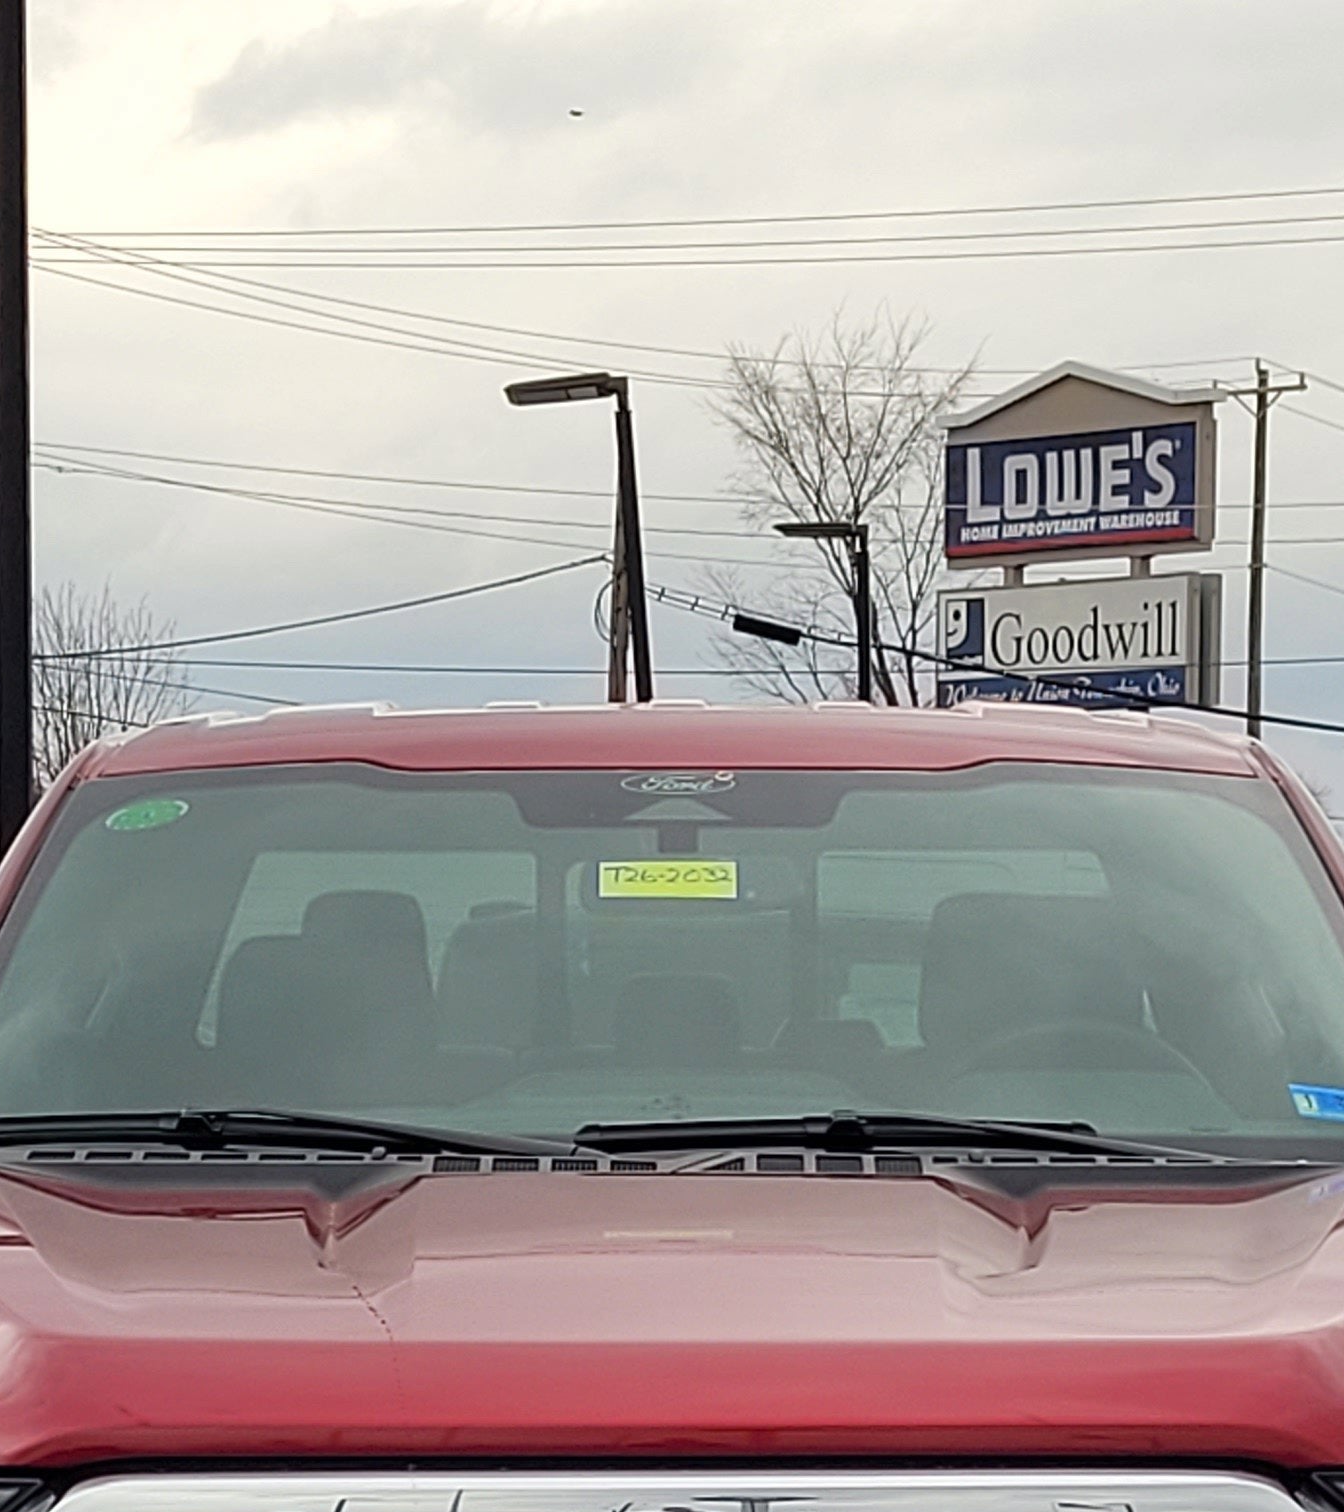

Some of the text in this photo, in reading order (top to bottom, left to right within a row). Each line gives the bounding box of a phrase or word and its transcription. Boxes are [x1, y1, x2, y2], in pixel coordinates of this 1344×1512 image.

[966, 431, 1176, 524] LOWE'S
[960, 510, 1180, 542] HOME IMPROVEMENT WAREHOUSE
[991, 601, 1179, 666] Goodwill
[603, 866, 733, 885] T26-2032
